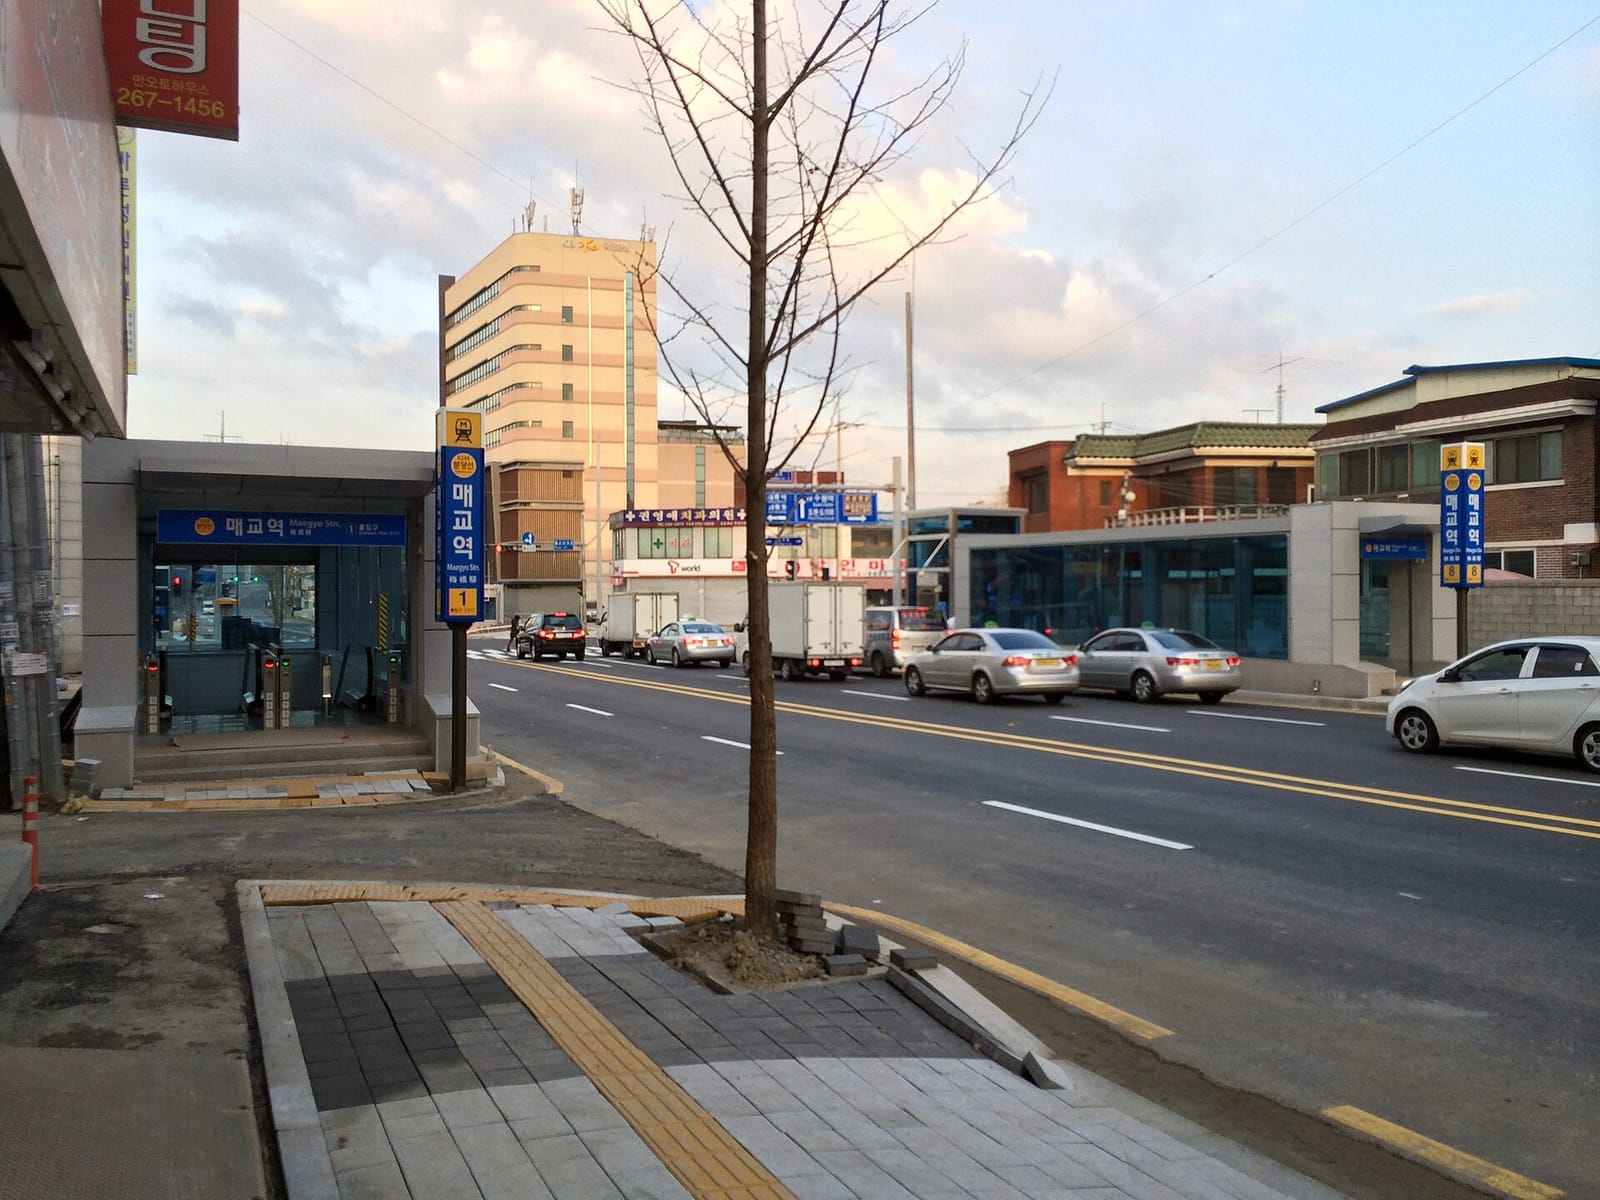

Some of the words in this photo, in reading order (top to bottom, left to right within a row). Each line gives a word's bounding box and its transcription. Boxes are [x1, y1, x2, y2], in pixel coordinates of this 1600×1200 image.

[117, 87, 225, 118] 267-1456
[225, 518, 284, 537] 매교역
[289, 519, 323, 529] Maegyo
[452, 483, 473, 560] 매교역
[1445, 494, 1458, 546] 매교역
[1467, 493, 1480, 546] 매교역
[447, 563, 469, 573] Maegyo
[459, 590, 466, 606] 1
